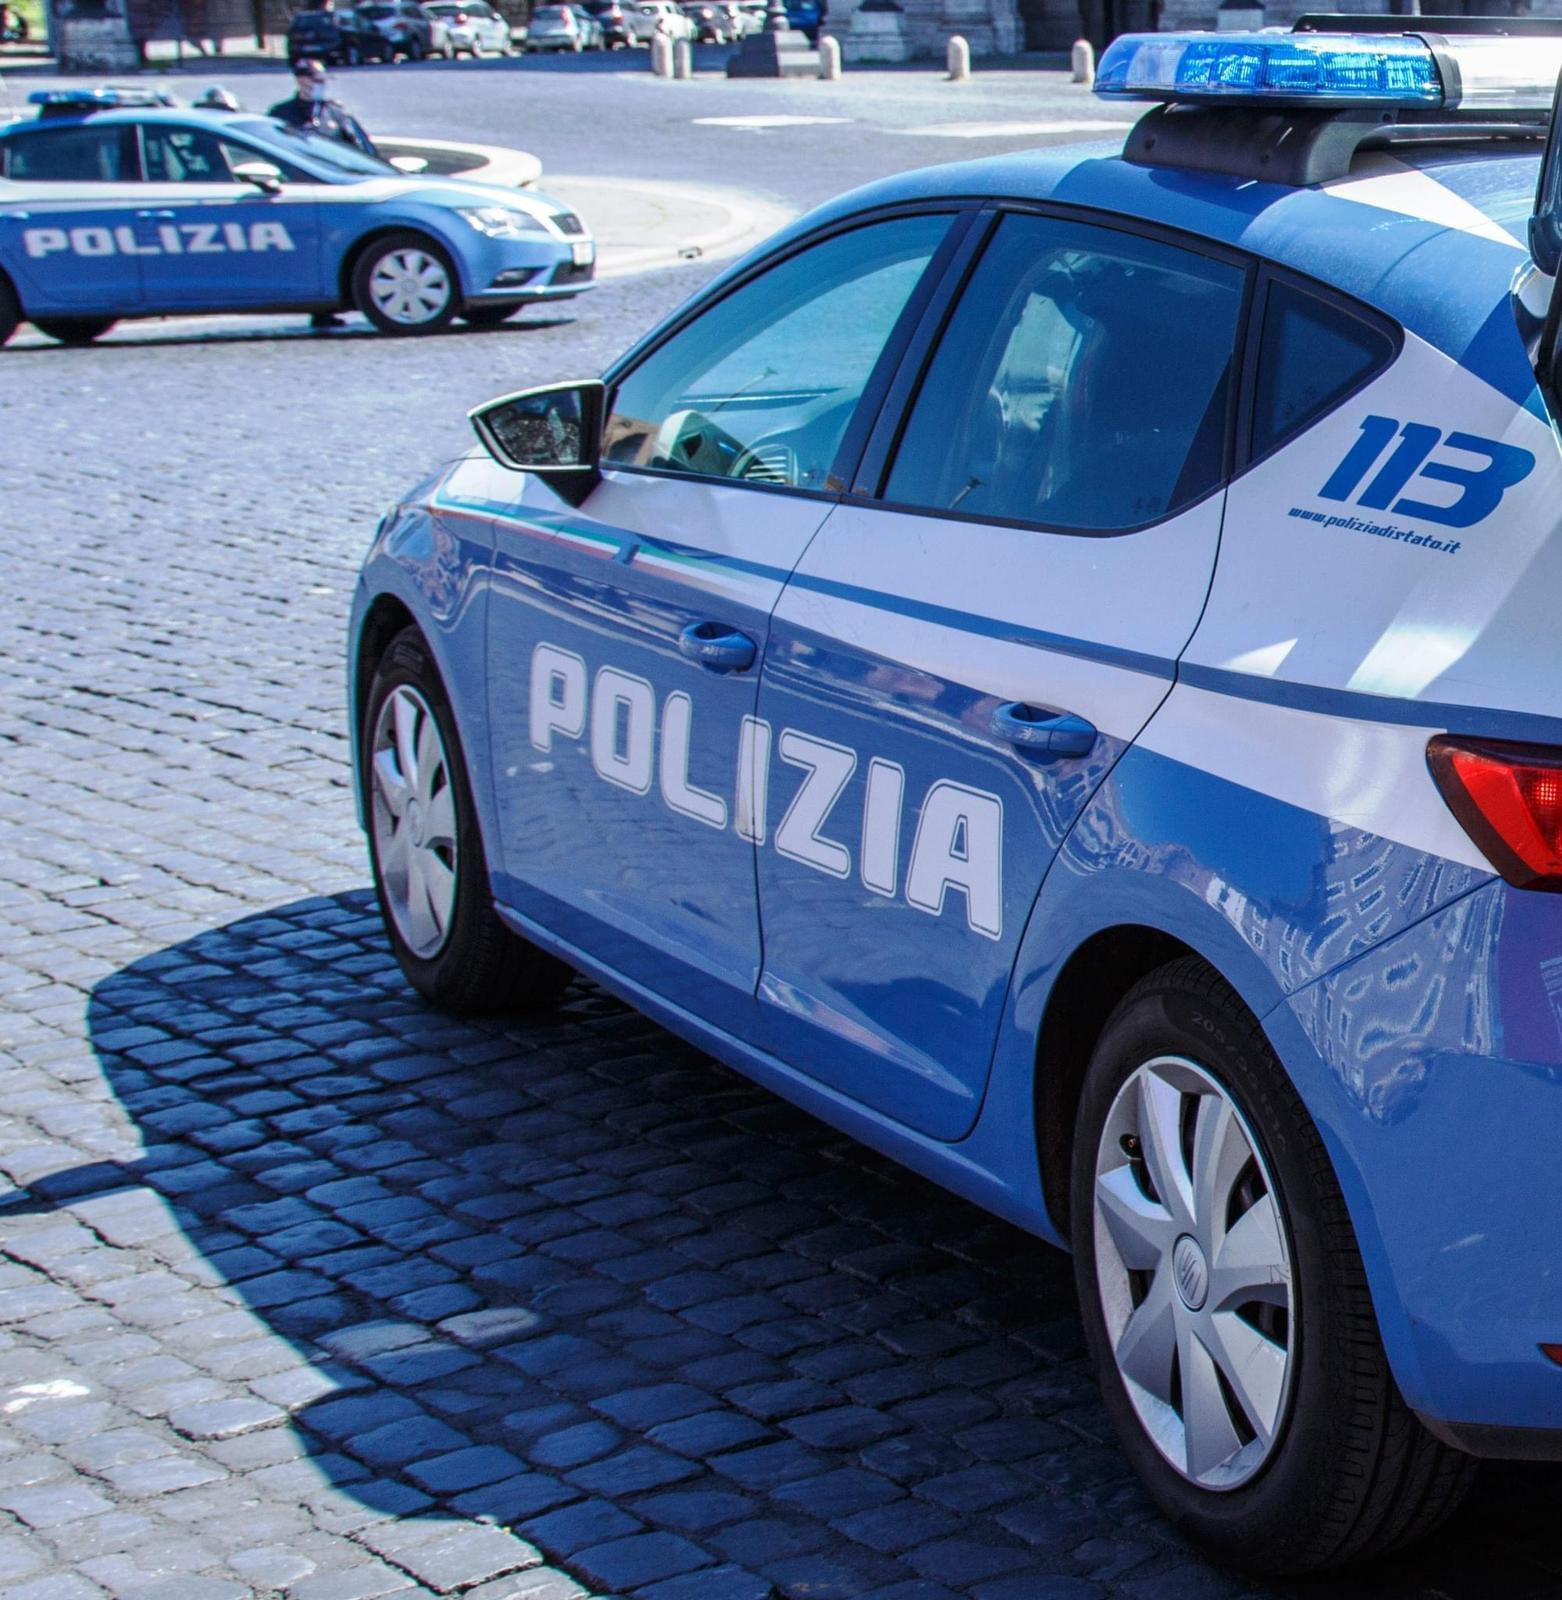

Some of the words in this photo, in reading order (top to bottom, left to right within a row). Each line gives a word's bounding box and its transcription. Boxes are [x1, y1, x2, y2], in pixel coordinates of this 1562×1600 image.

[24, 222, 295, 258] POLIZIA
[1317, 414, 1536, 529] 113
[1288, 507, 1462, 554] www.poliziadistato.it
[530, 641, 1003, 941] POLIZIA
